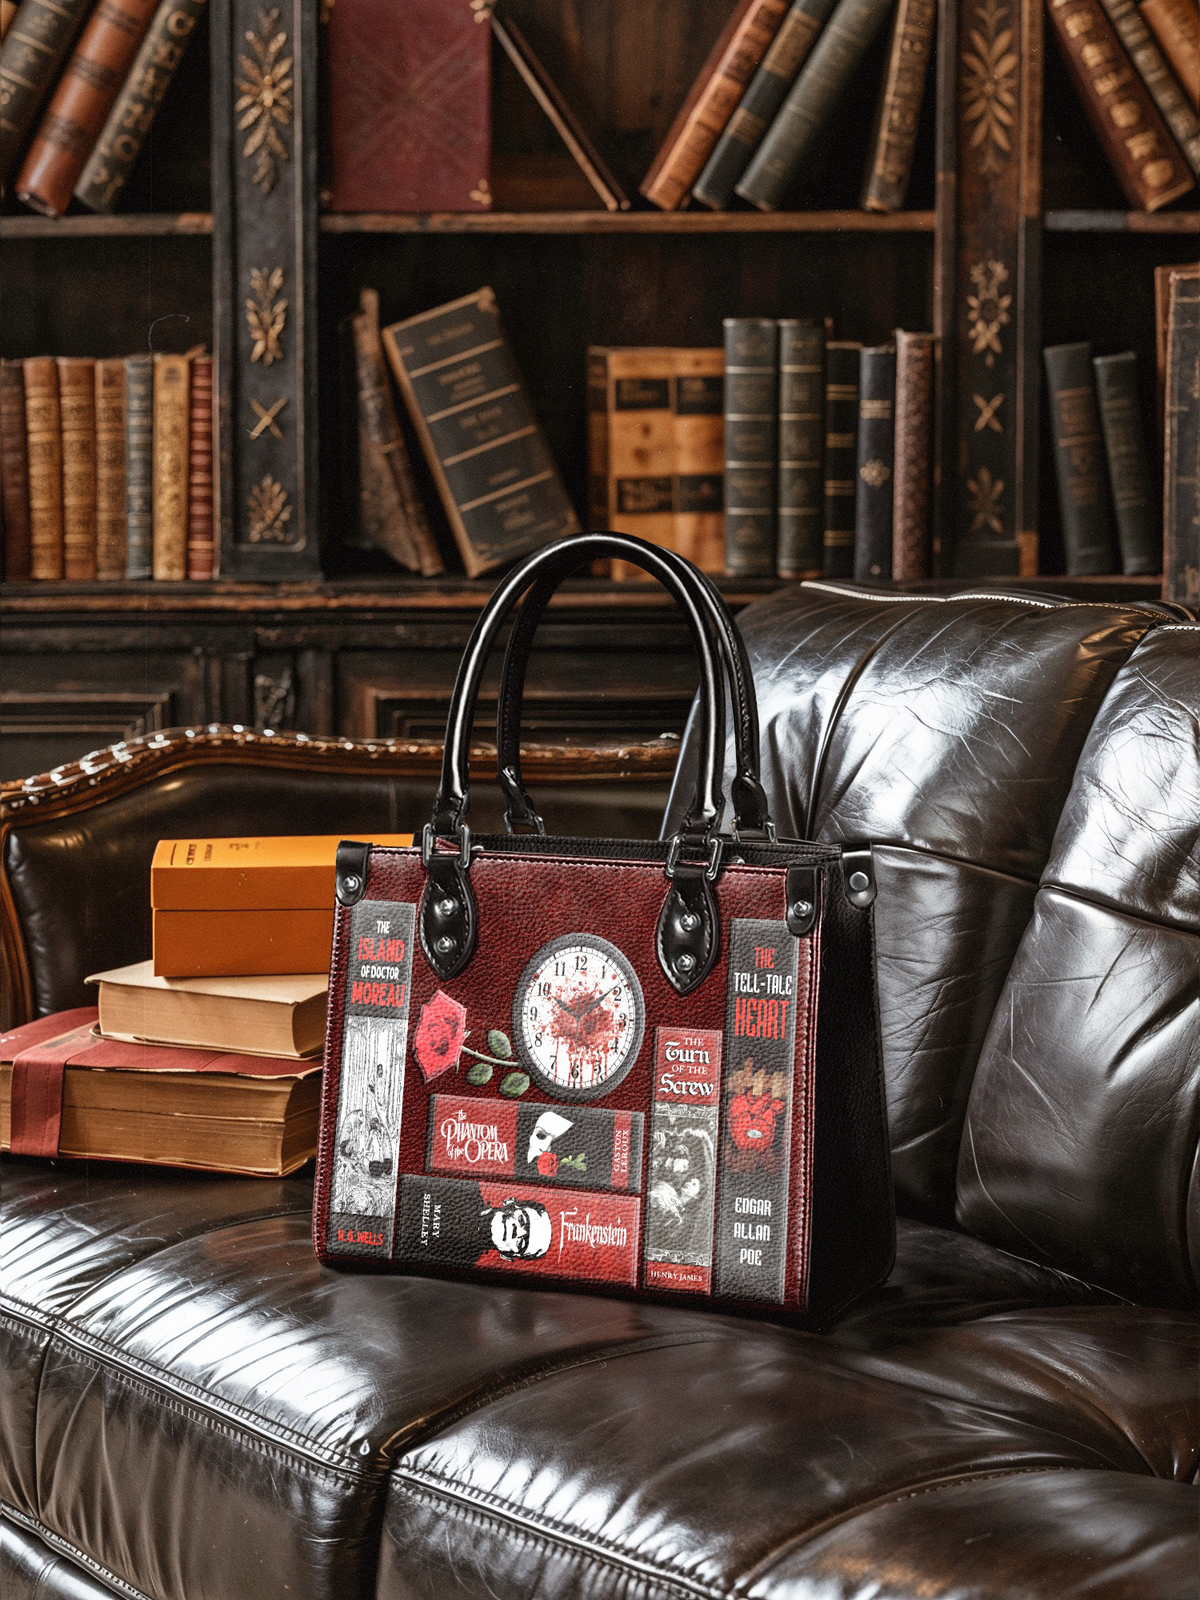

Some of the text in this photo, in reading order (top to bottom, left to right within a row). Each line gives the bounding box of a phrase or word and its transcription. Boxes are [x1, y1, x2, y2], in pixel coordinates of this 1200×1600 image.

[377, 921, 390, 934] THE
[358, 937, 405, 963] ISLAND
[754, 947, 775, 969] THE
[555, 961, 566, 977] 11
[574, 956, 588, 971] 12
[601, 964, 606, 979] 1
[361, 965, 400, 980] OF DOCTOR
[537, 982, 550, 997] 10
[734, 972, 793, 995] TELL-TALE
[351, 981, 405, 1008] MOREAU
[614, 986, 622, 1002] 2
[529, 1006, 538, 1021] 9
[618, 1013, 627, 1028] 3
[734, 998, 790, 1040] HEART
[534, 1032, 543, 1048] 8
[611, 1037, 619, 1053] 4
[683, 1037, 704, 1046] THE
[664, 1041, 710, 1064] Turn
[549, 1055, 557, 1070] 7
[594, 1060, 602, 1074] 5
[672, 1064, 708, 1074] OF THE
[571, 1064, 580, 1079] 6
[657, 1073, 714, 1096] Screw
[451, 1109, 467, 1122] the
[448, 1138, 508, 1164] of the OPERA
[613, 1129, 622, 1172] GASTON
[620, 1129, 629, 1173] LEROUX
[735, 1197, 772, 1216] EDGAR
[420, 1193, 431, 1246] SHELLEY
[432, 1204, 442, 1238] MARY
[337, 1229, 384, 1246] H. G. WELLS
[558, 1207, 627, 1262] Frankenstein
[734, 1222, 770, 1241] ALLAN
[740, 1248, 762, 1266] POE
[650, 1270, 703, 1282] HENRY JAMES
